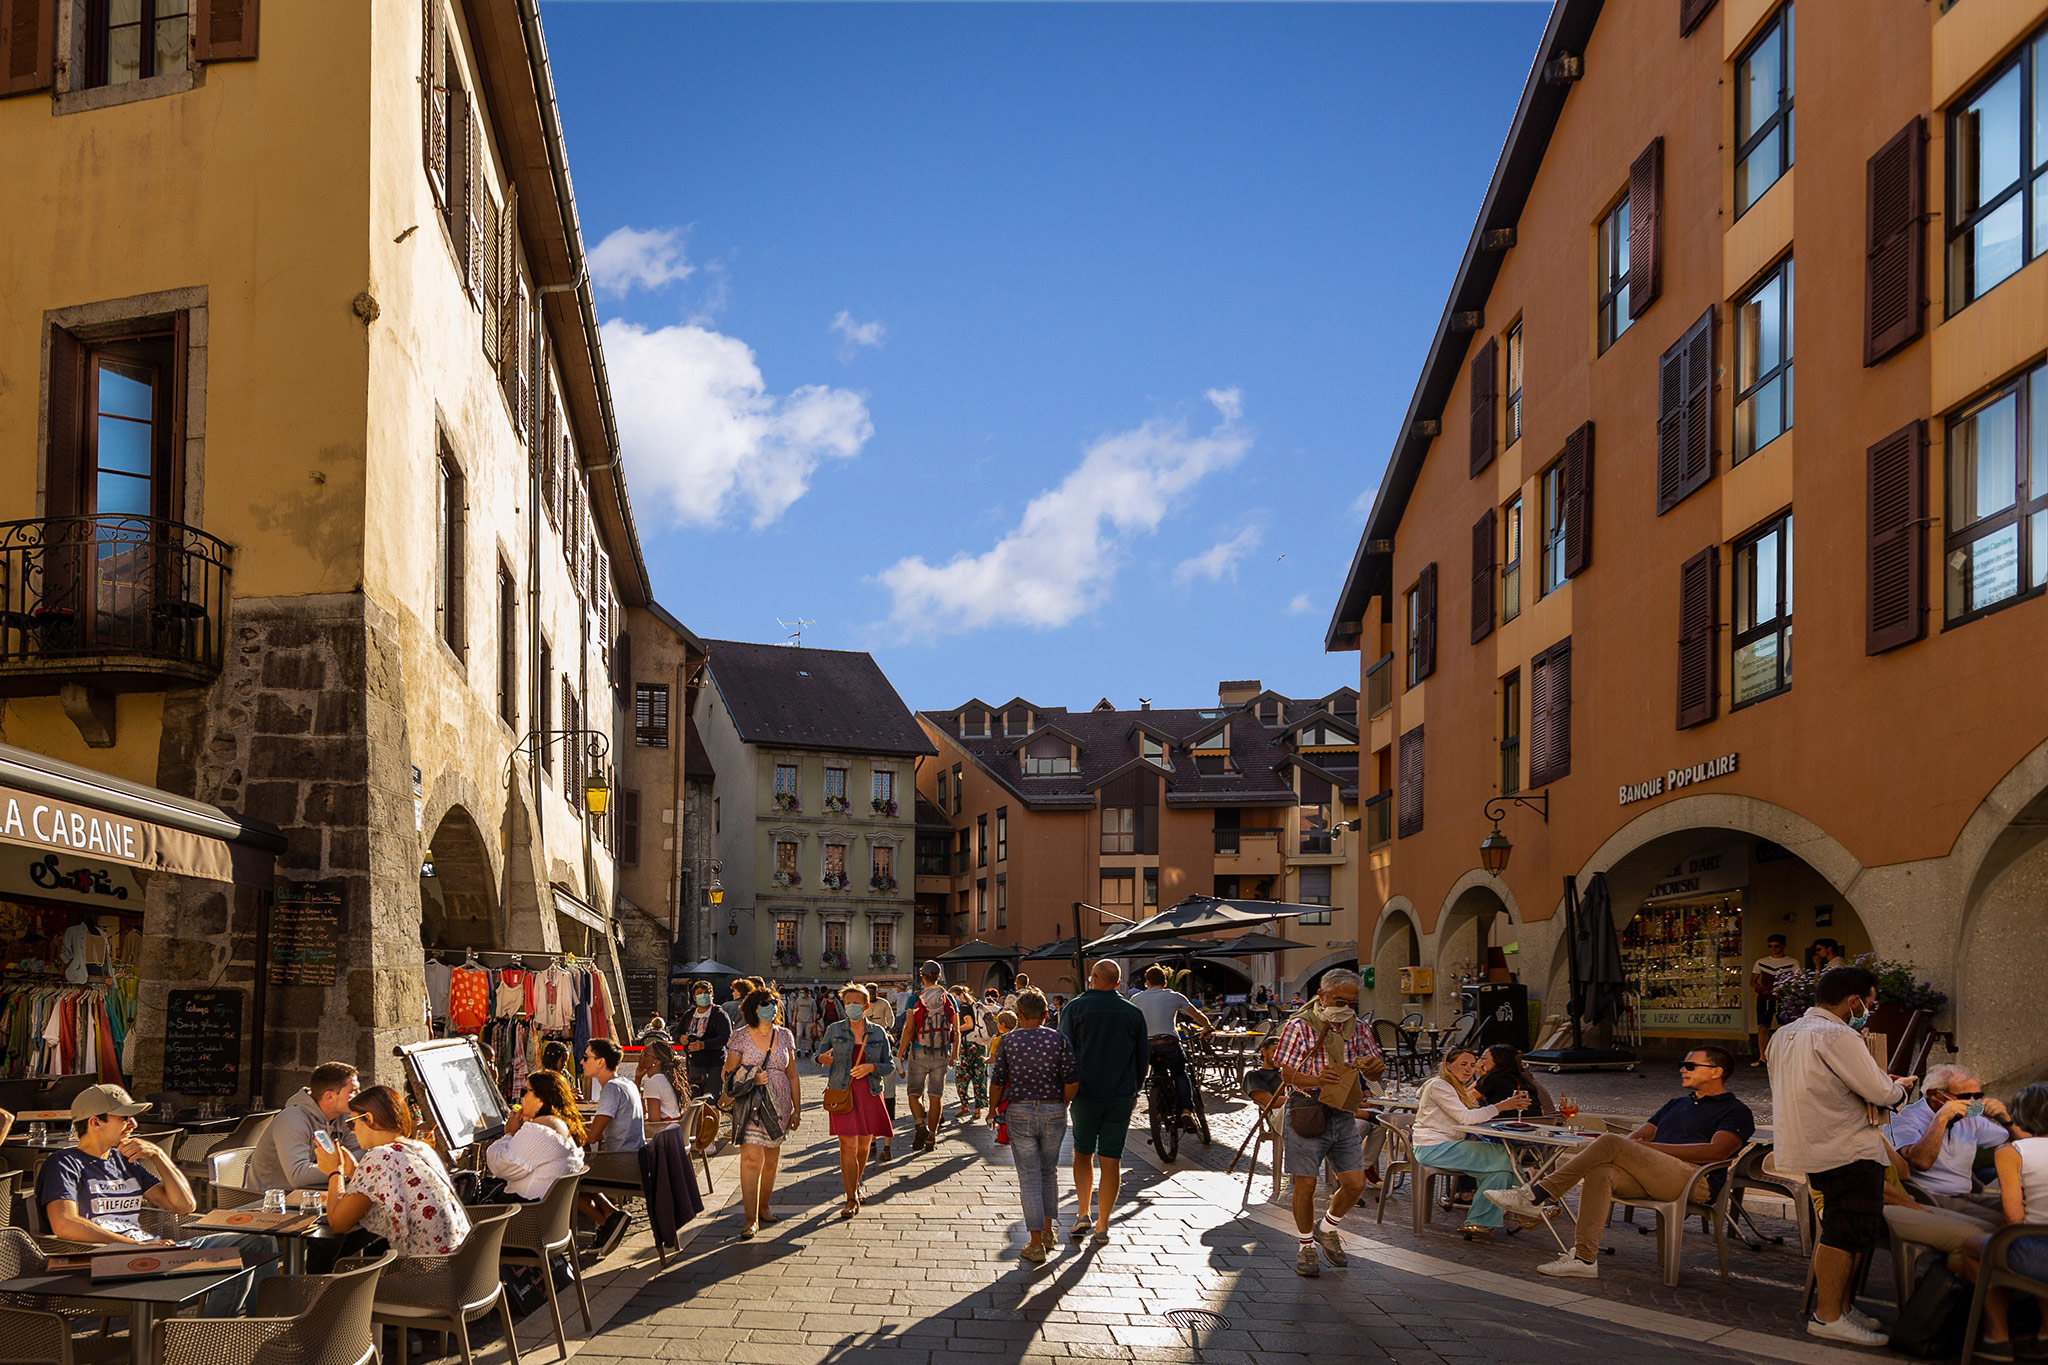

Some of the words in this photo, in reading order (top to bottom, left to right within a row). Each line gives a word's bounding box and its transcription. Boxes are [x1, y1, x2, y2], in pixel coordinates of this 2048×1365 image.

[1619, 777, 1663, 805] BANQUE
[1667, 753, 1737, 790] POPULAIRE
[33, 805, 136, 858] CABANE
[1689, 854, 1721, 874] D'ART
[1653, 1013, 1681, 1024] VERRE
[1687, 1012, 1733, 1024] CREATION
[97, 1198, 141, 1211] HILFIGER
